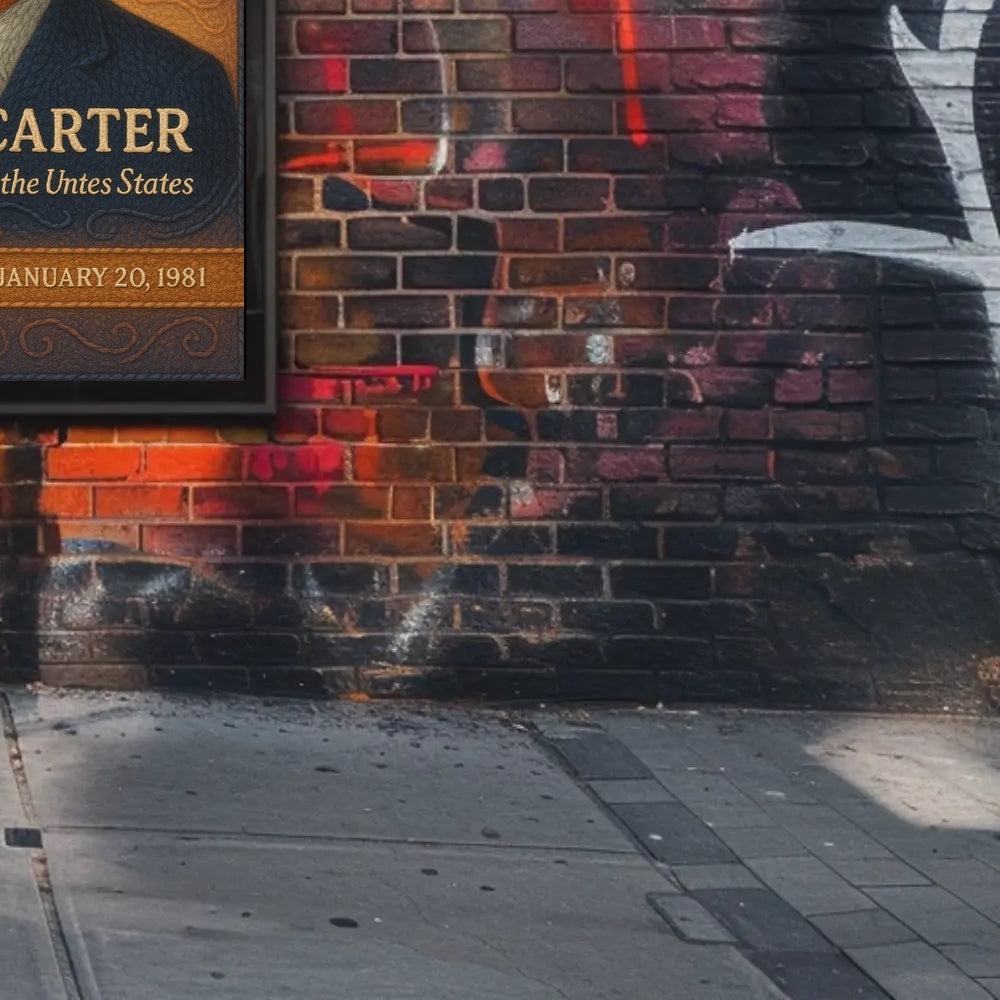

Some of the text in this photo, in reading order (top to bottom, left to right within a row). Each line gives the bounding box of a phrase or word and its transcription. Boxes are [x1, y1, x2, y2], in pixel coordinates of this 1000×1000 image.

[0, 168, 39, 195] the
[45, 168, 112, 195] Untes
[116, 167, 194, 195] States
[114, 266, 151, 292] 20,
[157, 266, 206, 288] 1981
